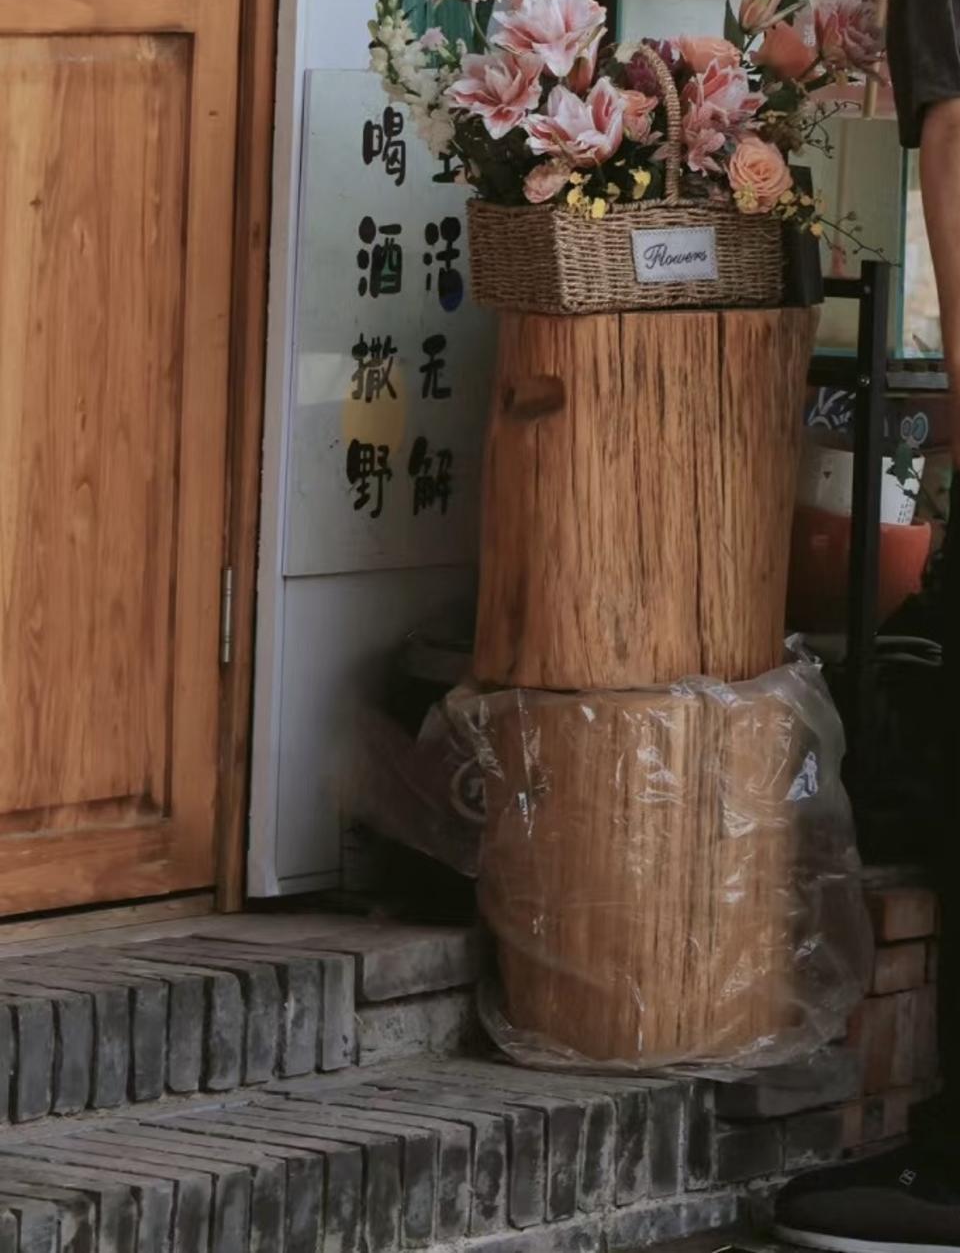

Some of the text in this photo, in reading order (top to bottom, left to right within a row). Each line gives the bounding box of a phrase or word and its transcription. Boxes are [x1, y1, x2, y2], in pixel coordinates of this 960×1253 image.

[346, 105, 407, 519] 喝酒撒野
[643, 242, 708, 270] Flowers
